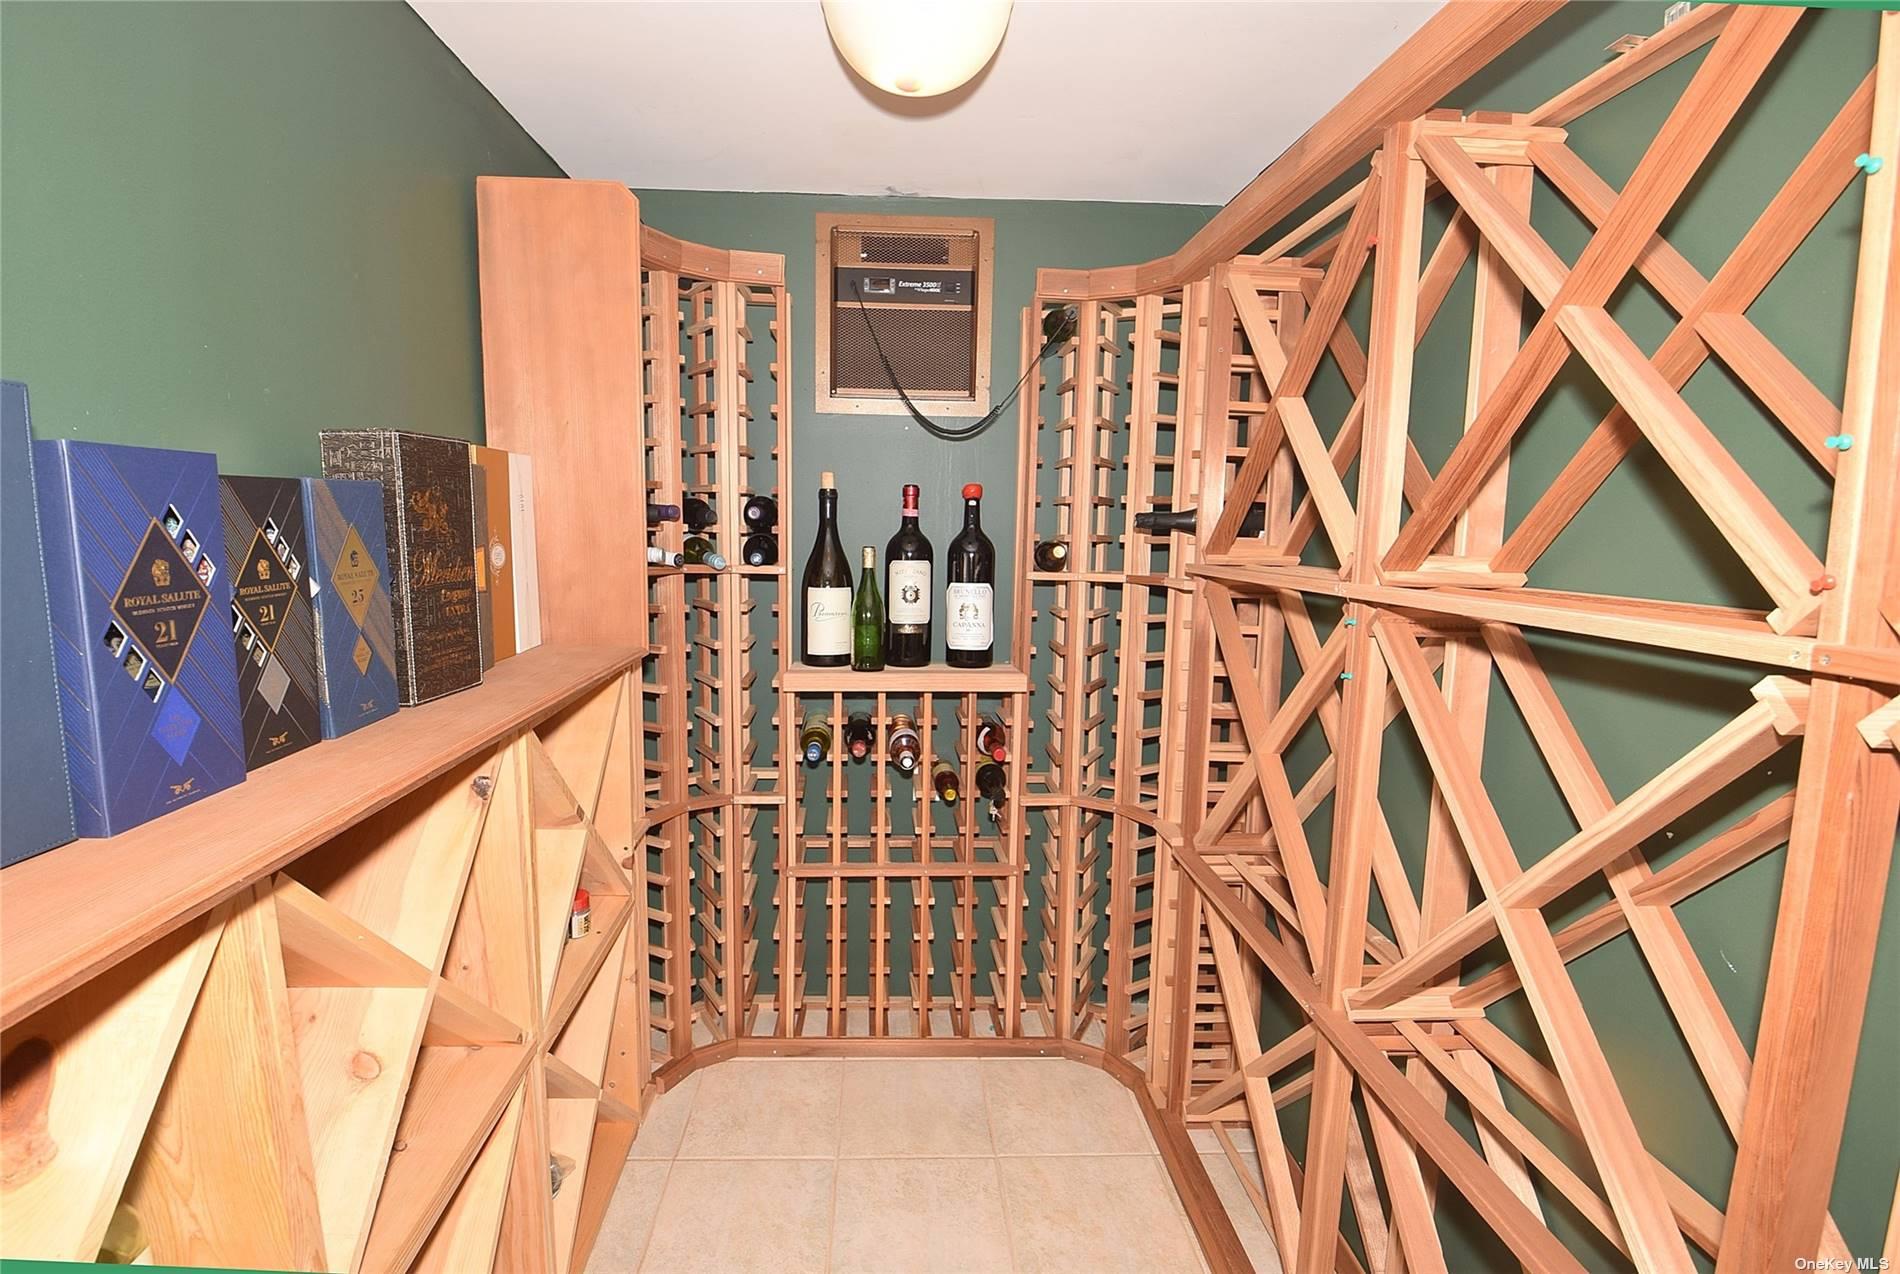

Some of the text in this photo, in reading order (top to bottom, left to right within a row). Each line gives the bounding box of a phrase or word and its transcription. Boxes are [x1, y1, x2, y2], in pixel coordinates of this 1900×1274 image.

[898, 280, 922, 288] Extreme
[239, 581, 291, 596] ROYAL SALUTE
[352, 588, 365, 604] 25
[123, 590, 201, 608] ROYAL SALUTE
[259, 604, 276, 622] 21
[154, 619, 177, 644] 21
